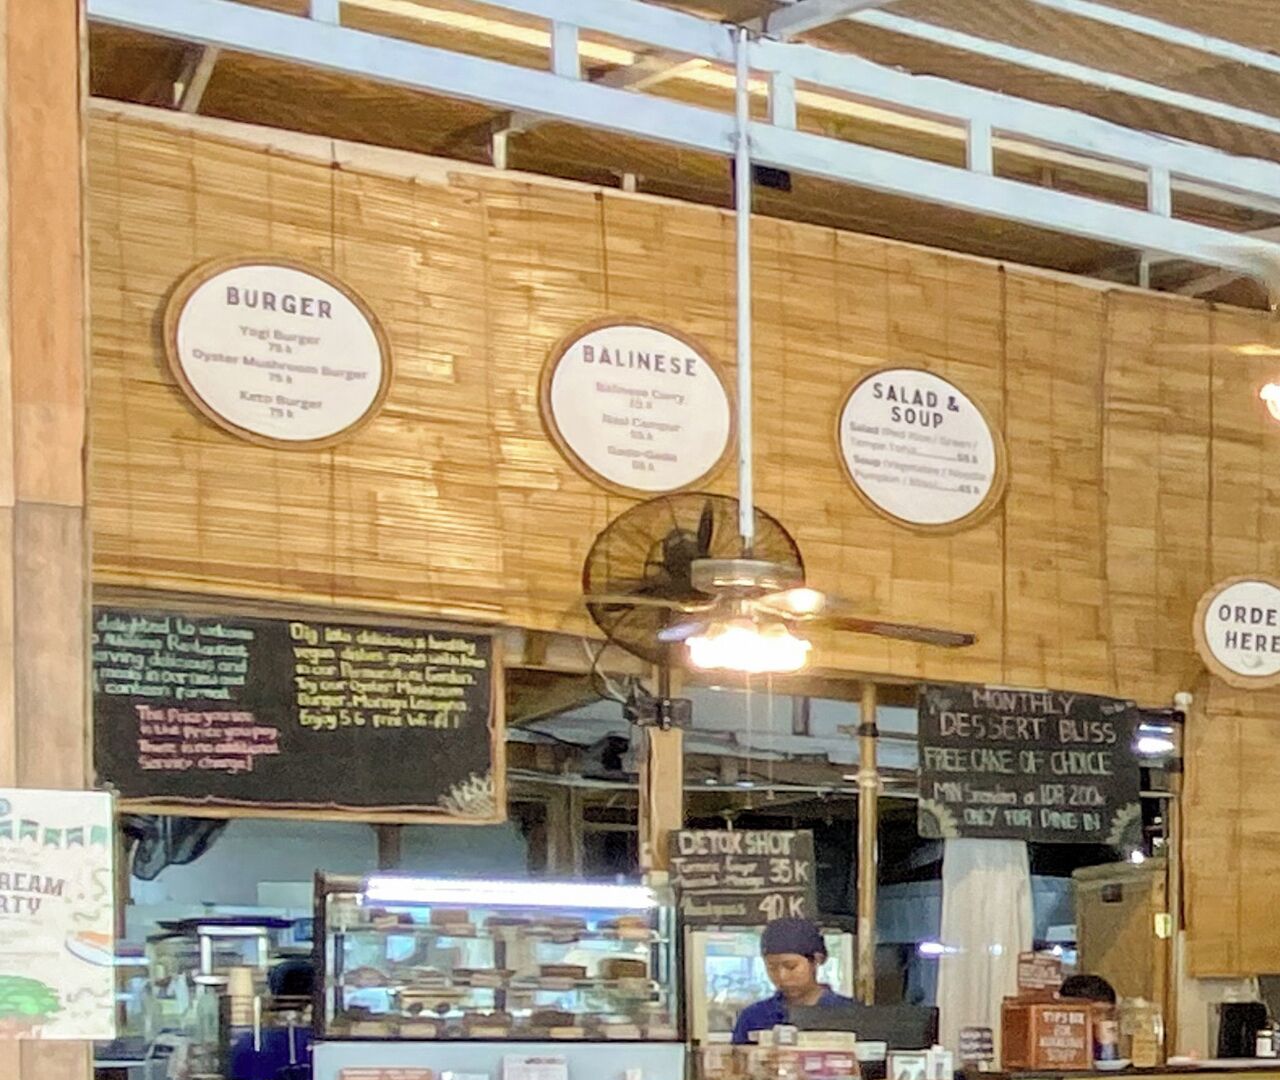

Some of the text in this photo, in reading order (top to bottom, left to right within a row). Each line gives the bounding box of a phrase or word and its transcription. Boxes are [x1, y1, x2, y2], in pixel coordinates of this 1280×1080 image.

[226, 286, 333, 319] BURGER
[273, 328, 321, 346] Burger
[192, 348, 239, 366] Oyster
[243, 355, 318, 375] Mushroom
[582, 344, 697, 377] BALINESE
[275, 394, 323, 410] Burger
[873, 382, 960, 413] SALAD &
[891, 406, 944, 429] SOUP
[972, 689, 1075, 715] MONTHLY
[940, 712, 1117, 744] DESSERT BLISS
[924, 747, 1115, 776] FREE CAKE OF CHOICE
[1004, 809, 1032, 828] FOR
[1040, 808, 1078, 830] DINE
[678, 830, 795, 855] DETOX SHOT
[794, 860, 809, 882] K
[0, 871, 66, 897] REAM
[0, 895, 42, 915] RTY
[789, 896, 805, 919] K
